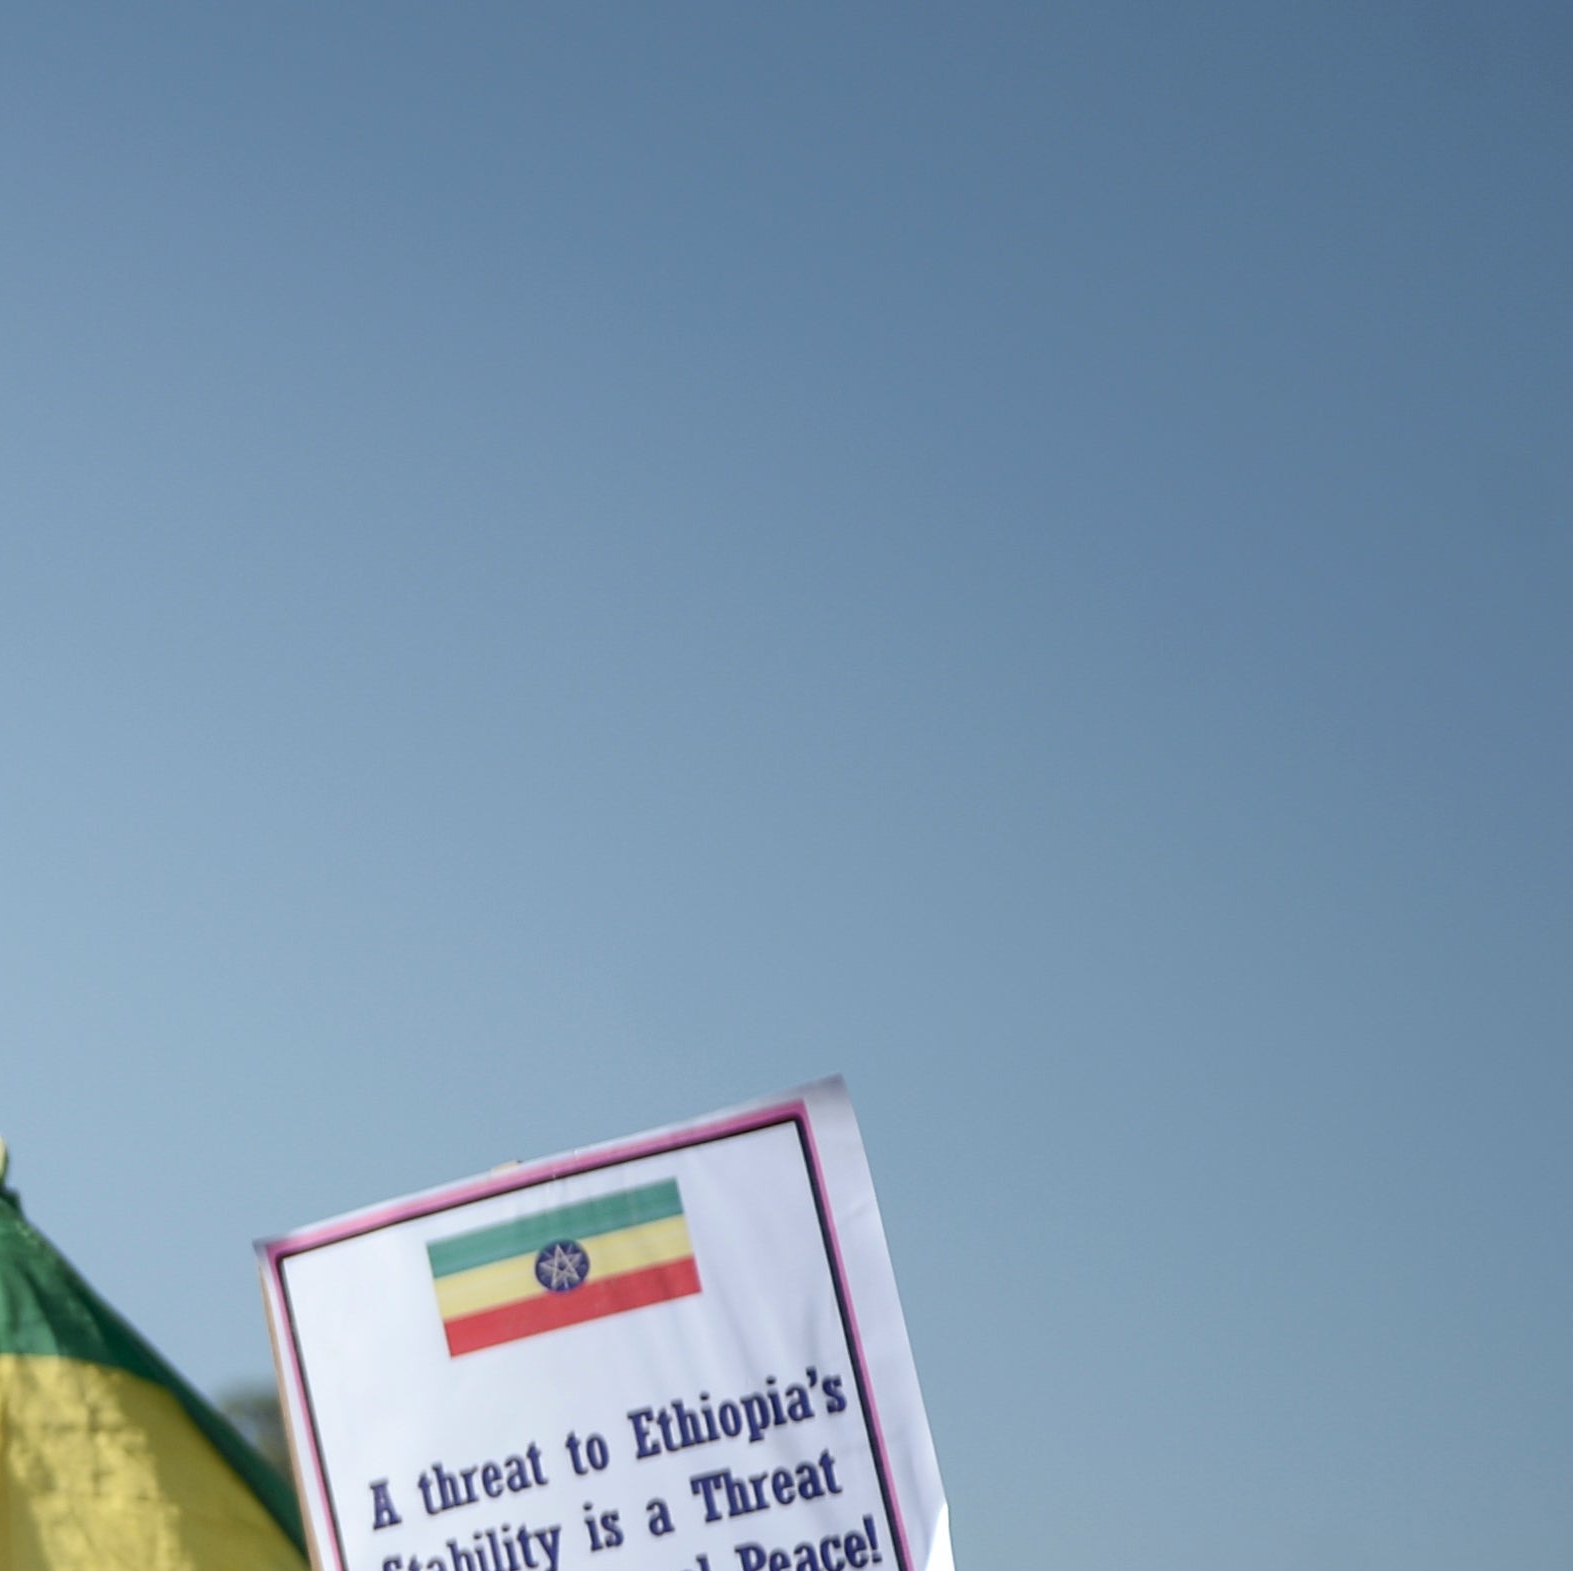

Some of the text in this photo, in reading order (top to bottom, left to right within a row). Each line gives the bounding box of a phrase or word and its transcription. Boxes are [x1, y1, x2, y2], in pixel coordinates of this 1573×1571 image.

[369, 1366, 847, 1532] A threat to Ethiopia's
[582, 1502, 625, 1553] is
[645, 1497, 676, 1538] a
[689, 1449, 843, 1524] Threat
